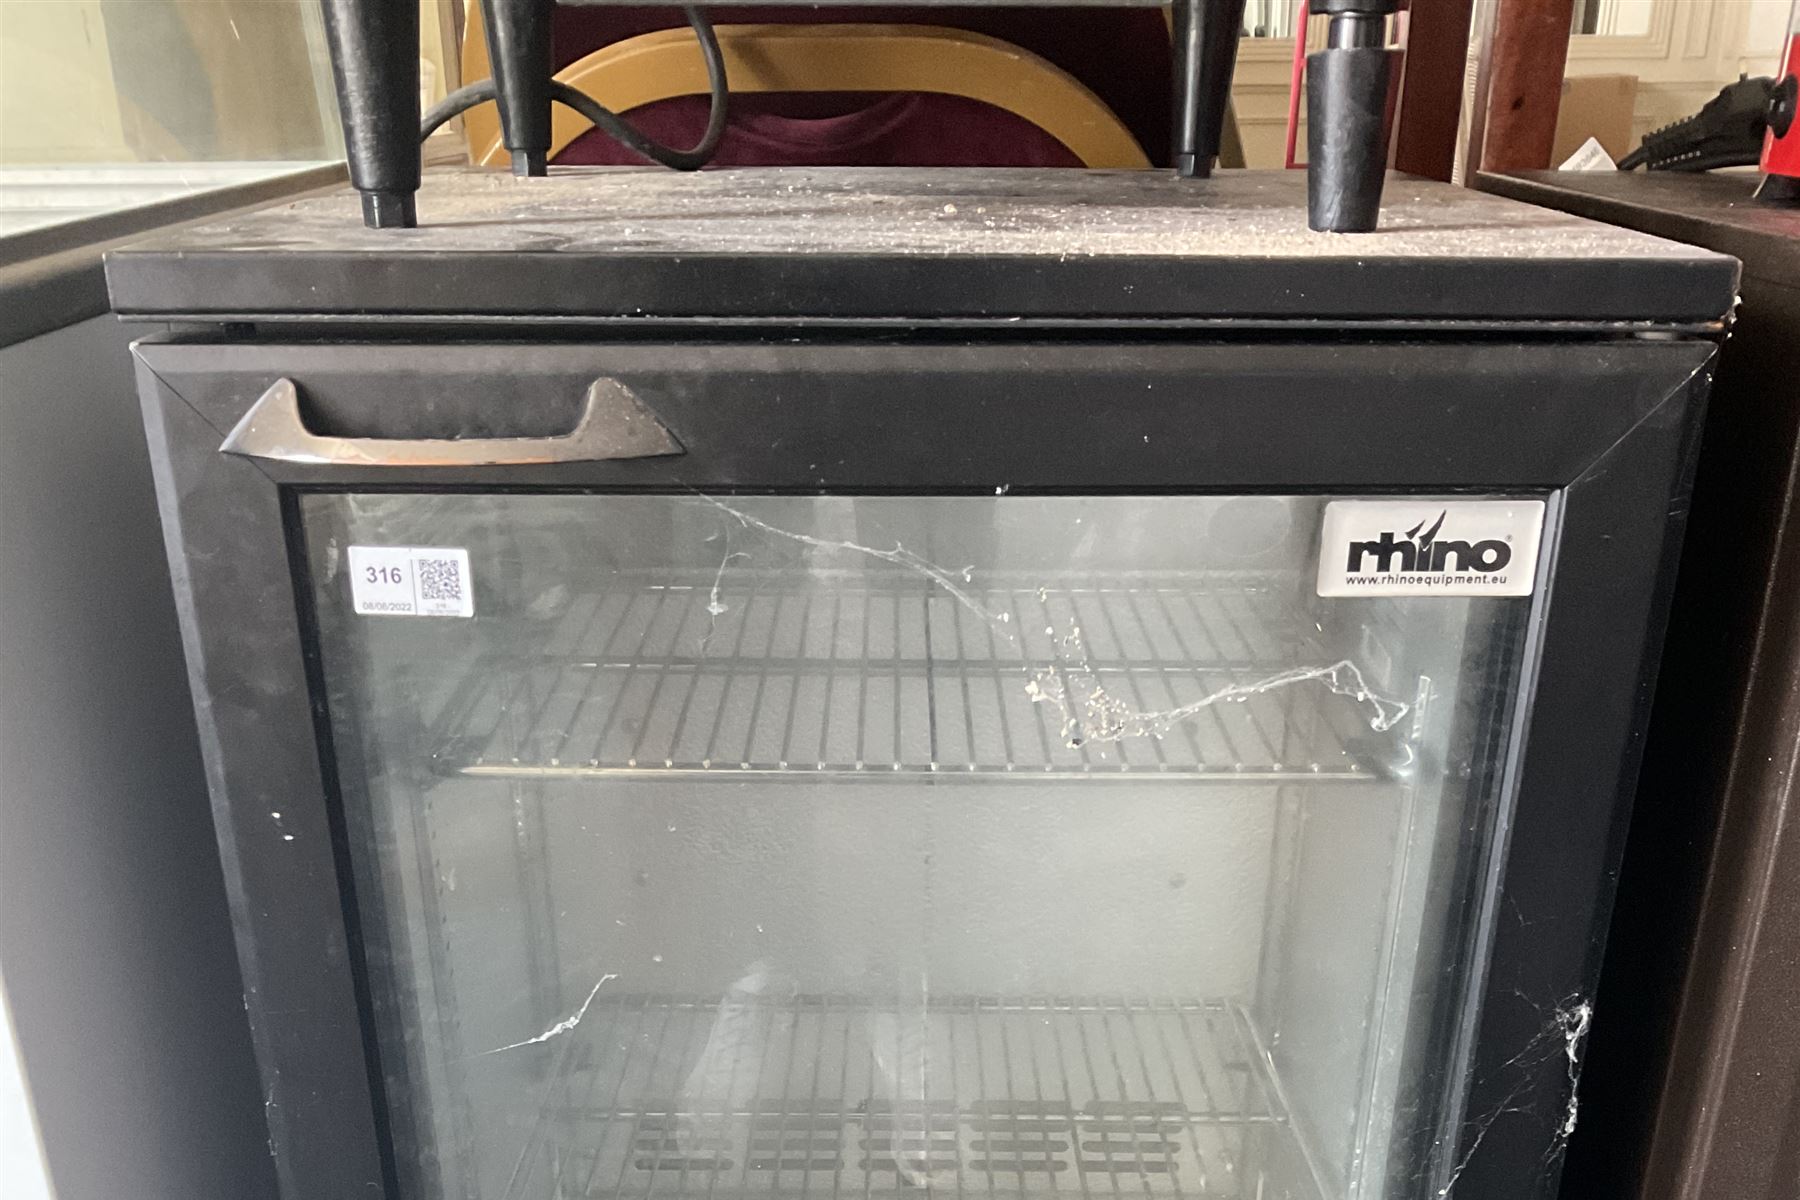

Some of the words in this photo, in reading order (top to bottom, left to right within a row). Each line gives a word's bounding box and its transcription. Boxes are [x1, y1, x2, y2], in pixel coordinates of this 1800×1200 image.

[1347, 510, 1512, 573] rhino
[366, 567, 402, 584] 316
[1346, 574, 1507, 586] www.rhinoequipment.eu
